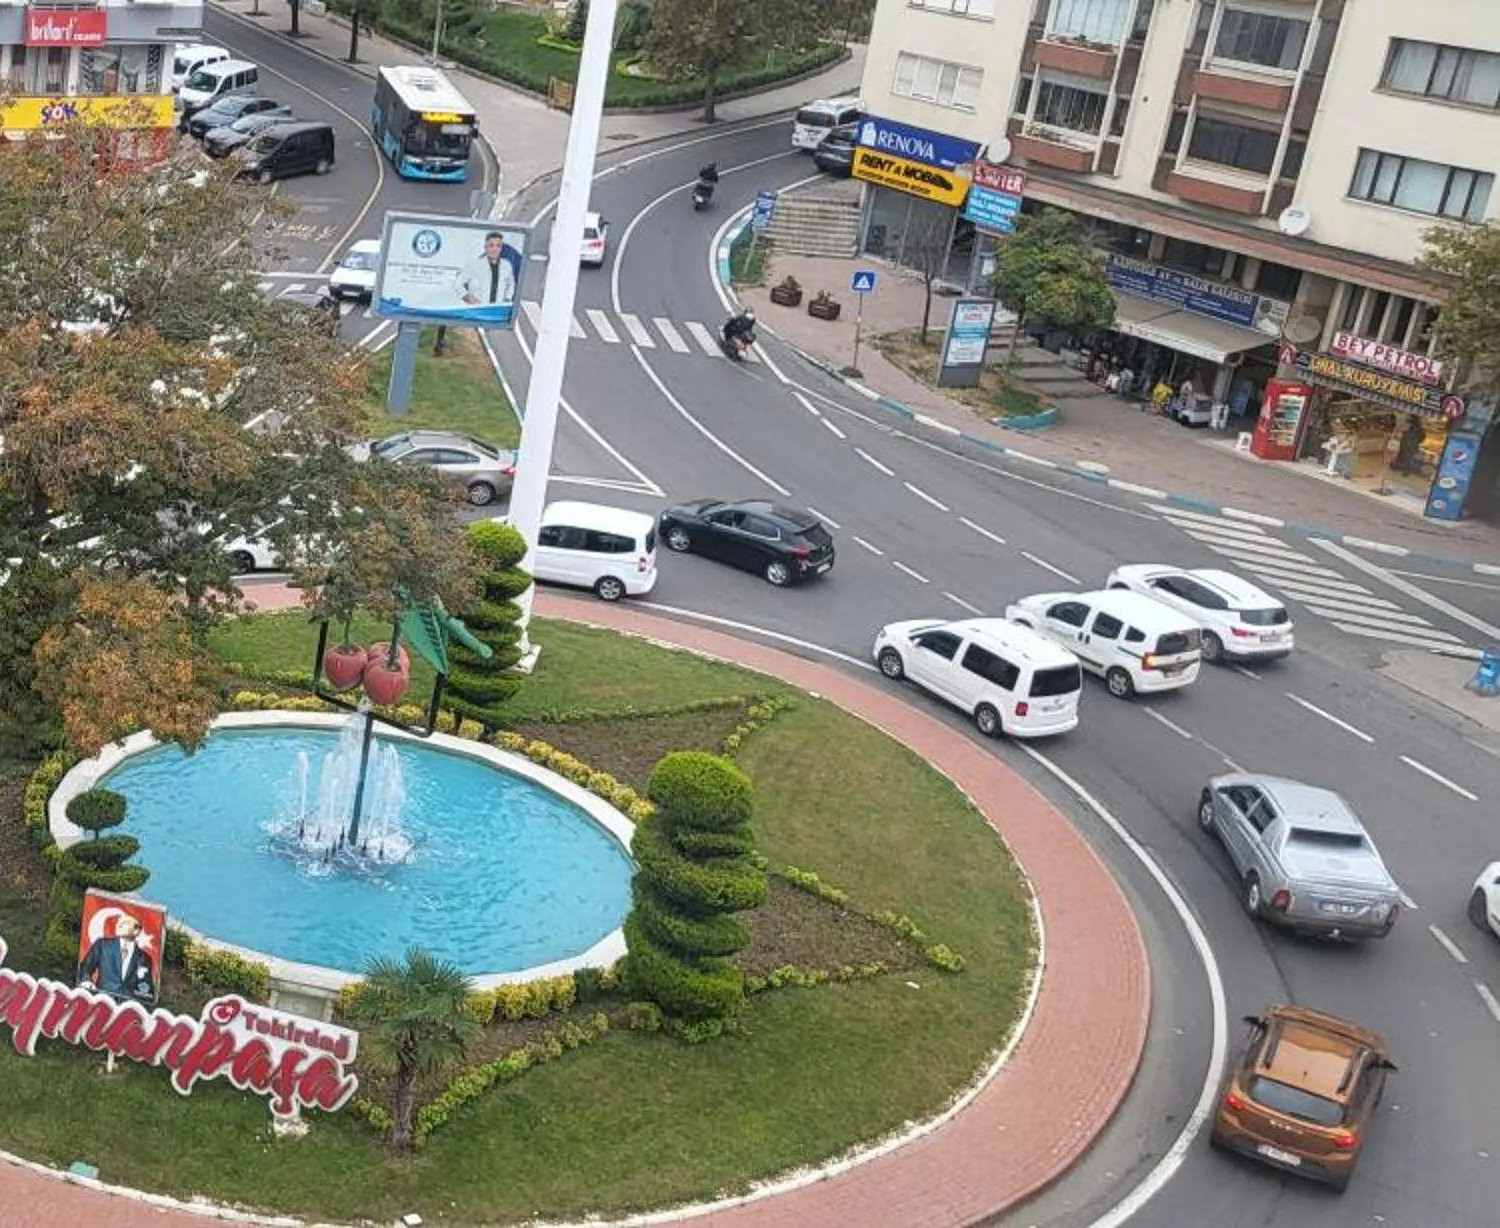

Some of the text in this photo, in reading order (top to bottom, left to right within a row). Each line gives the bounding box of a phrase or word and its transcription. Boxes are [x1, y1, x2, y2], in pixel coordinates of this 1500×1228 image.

[877, 129, 935, 161] RENOVA
[1337, 334, 1370, 354] BEY
[1373, 345, 1437, 376] PETROL
